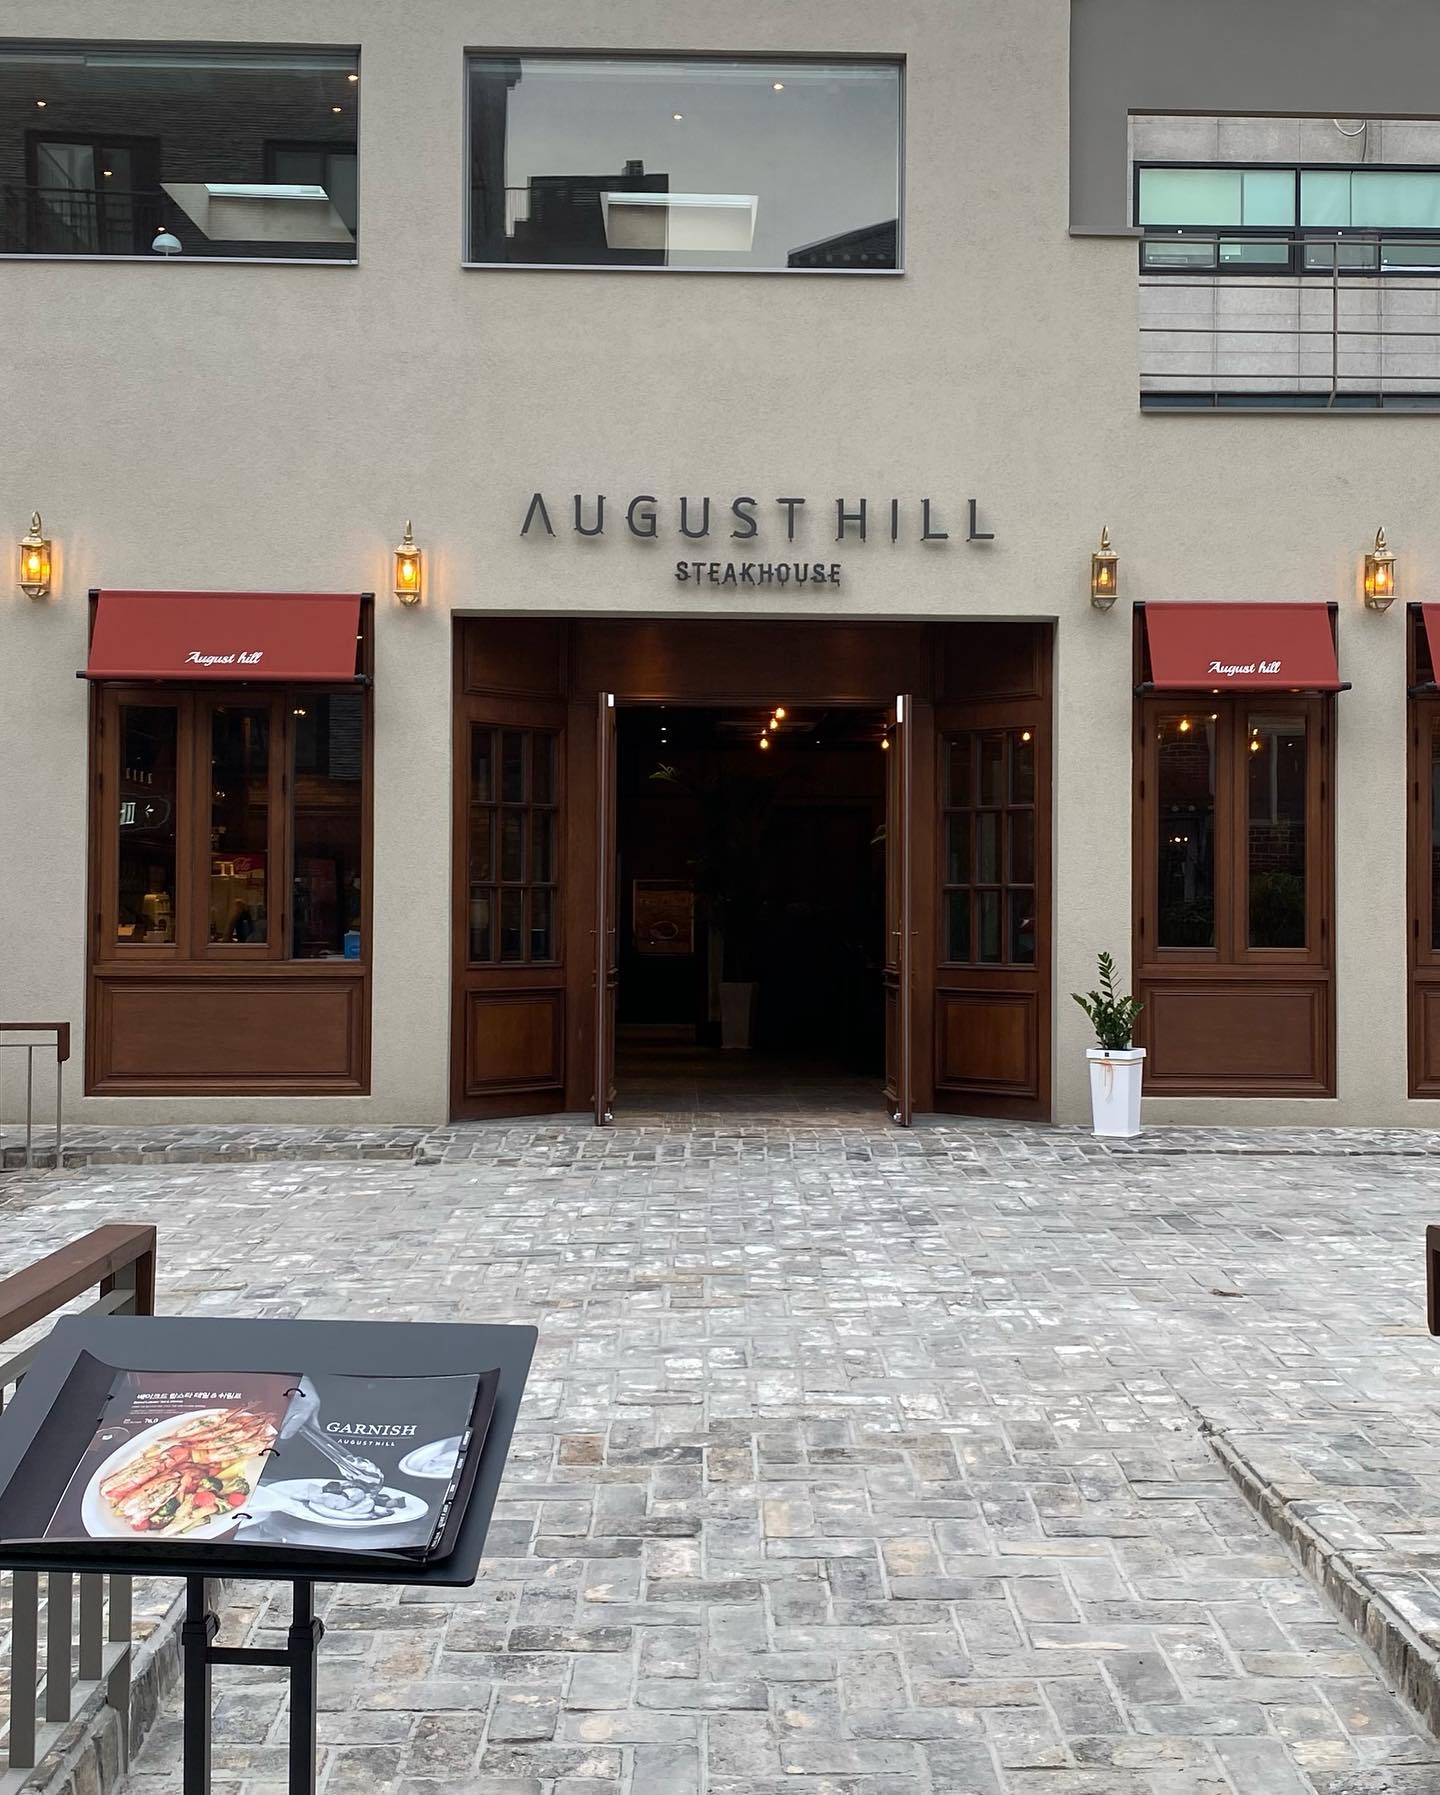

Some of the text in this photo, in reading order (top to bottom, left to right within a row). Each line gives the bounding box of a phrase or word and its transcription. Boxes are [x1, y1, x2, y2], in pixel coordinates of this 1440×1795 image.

[520, 493, 995, 542] AUGUST HILL
[674, 560, 842, 586] STEAKHOUSE
[185, 651, 264, 667] August hill
[1207, 660, 1282, 677] August hill
[326, 1422, 418, 1436] GARNISH
[337, 1438, 373, 1447] AUGUST
